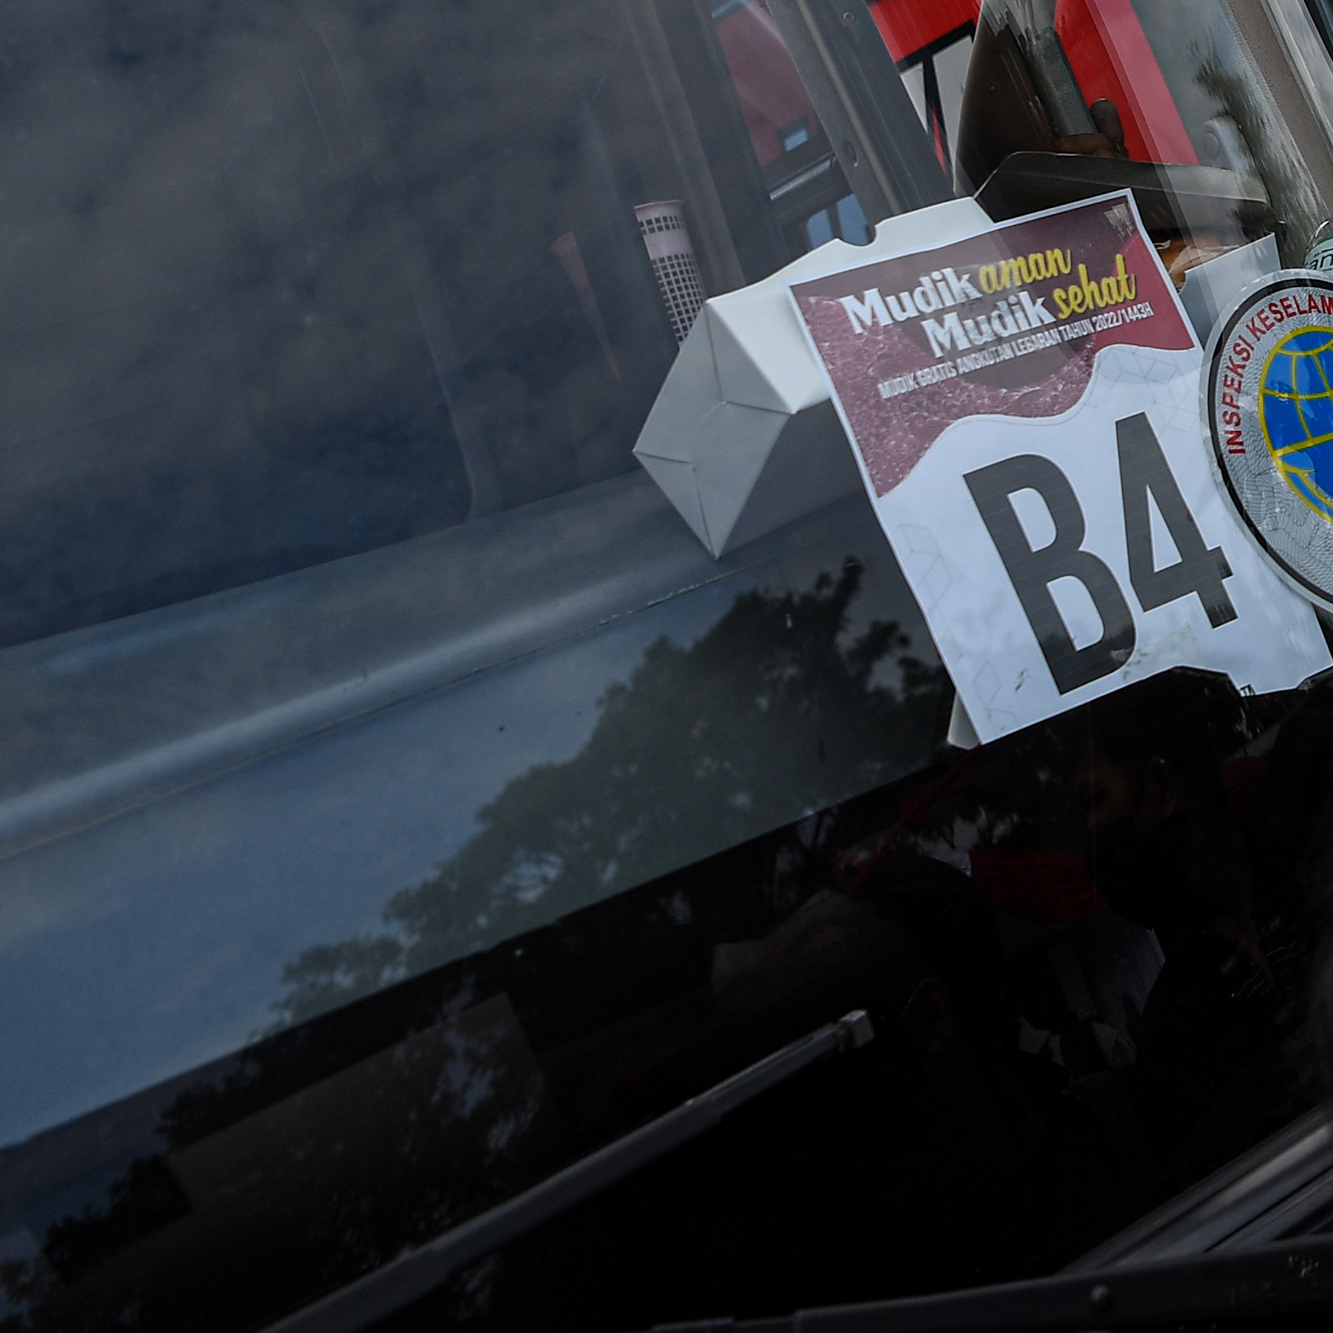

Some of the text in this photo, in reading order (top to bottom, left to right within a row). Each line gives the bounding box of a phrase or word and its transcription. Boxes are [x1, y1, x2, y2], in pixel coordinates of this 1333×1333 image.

[838, 247, 1072, 335] Mudik aman
[920, 253, 1137, 359] Mudik sehat
[877, 302, 1155, 399] MUDIK GRATIS ANGKUTAN LEBARAN TAHUN 2022/1443H
[1222, 334, 1255, 455] INSPEKSI
[962, 410, 1241, 697] B4
